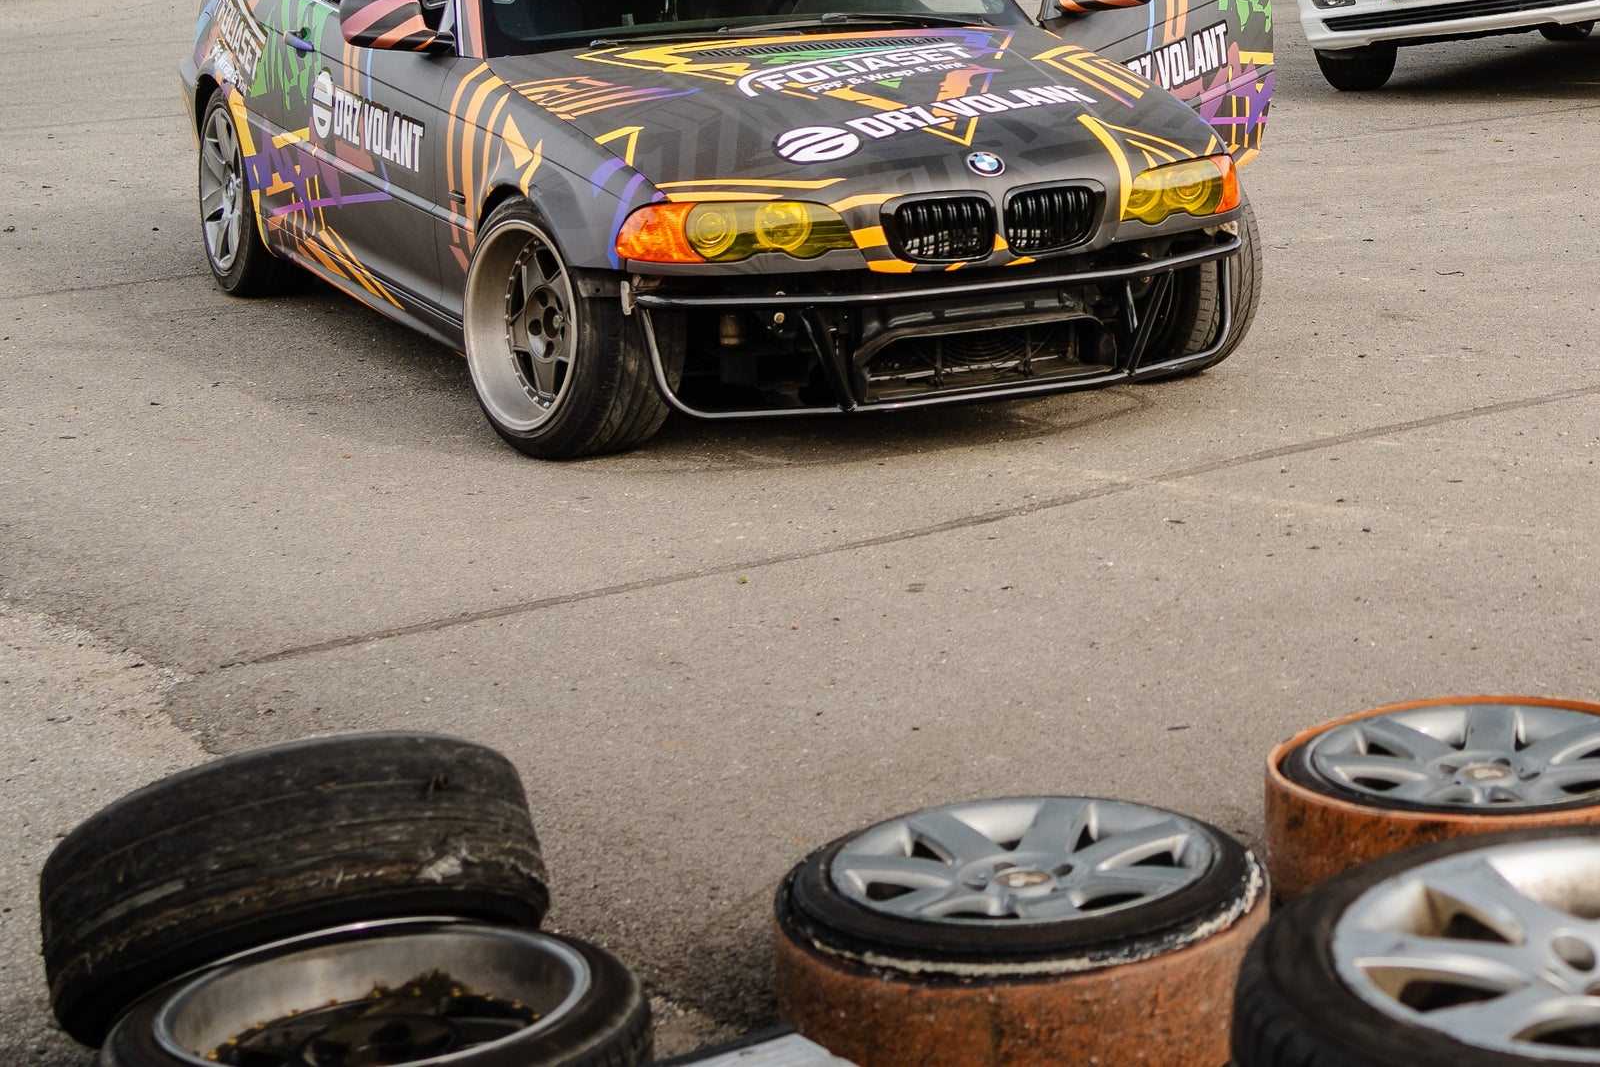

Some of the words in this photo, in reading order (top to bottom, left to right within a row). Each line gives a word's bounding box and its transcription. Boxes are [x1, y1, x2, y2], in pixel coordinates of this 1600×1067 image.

[757, 45, 973, 91] FOLIASET
[808, 81, 844, 93] PPF
[847, 74, 864, 85] &
[862, 68, 915, 82] Wrap
[1155, 22, 1227, 90] VOLANT
[334, 88, 362, 146] DRZ
[364, 102, 424, 173] VOLANT
[845, 106, 950, 139] DRZ
[931, 85, 1097, 117] VOLANT
